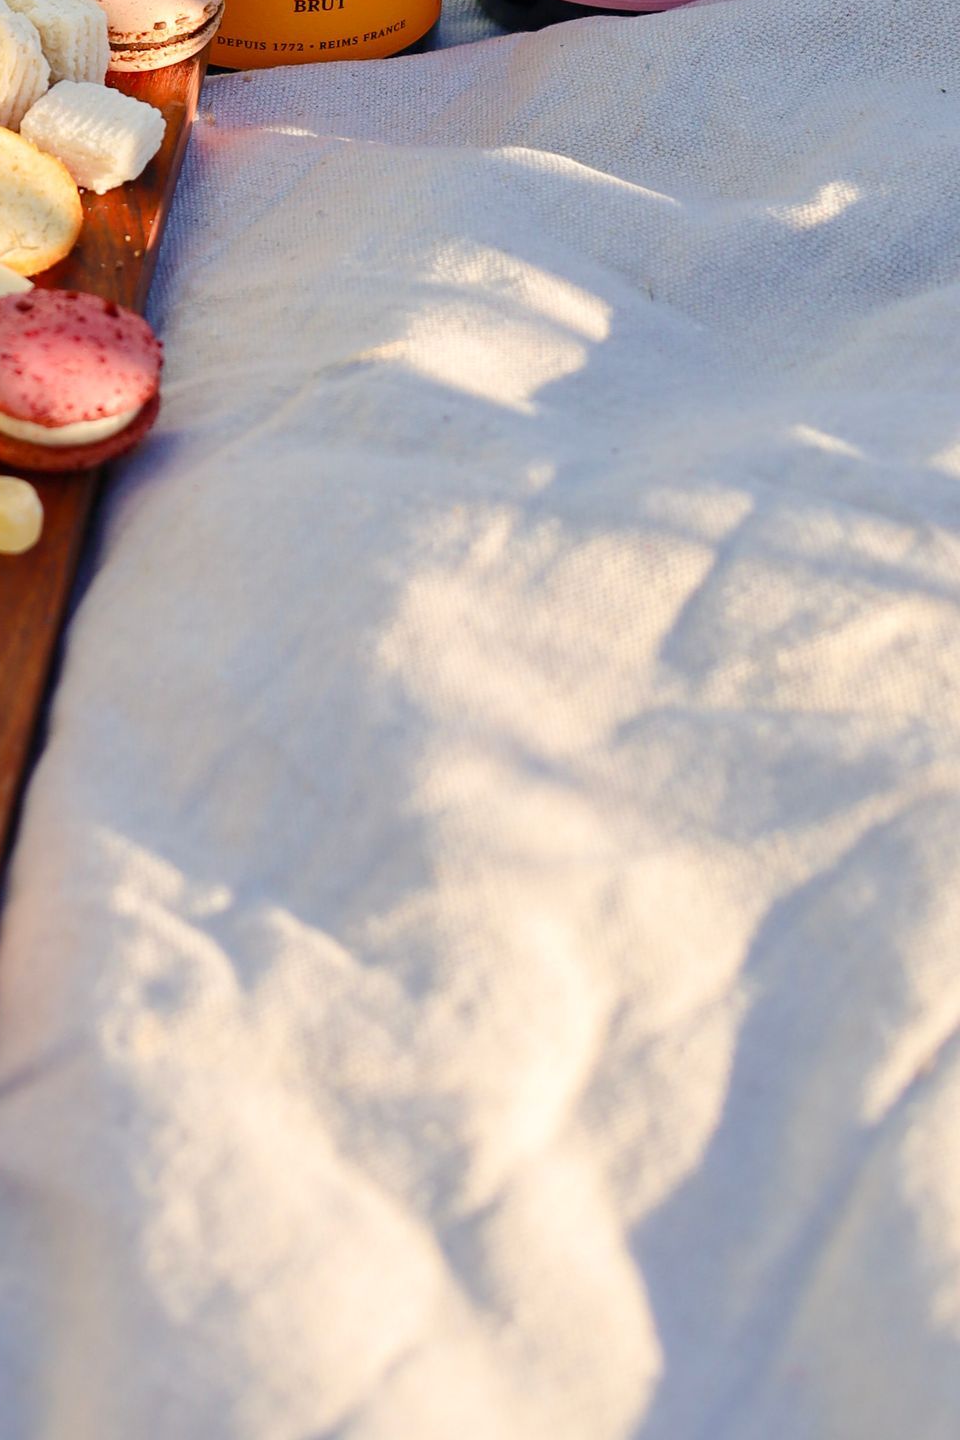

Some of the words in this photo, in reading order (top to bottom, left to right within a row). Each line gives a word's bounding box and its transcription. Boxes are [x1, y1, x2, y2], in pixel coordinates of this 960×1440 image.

[217, 35, 267, 51] DEPUIS
[273, 42, 304, 52] 1772
[319, 36, 358, 50] REIMS
[363, 19, 407, 42] FRANCE
